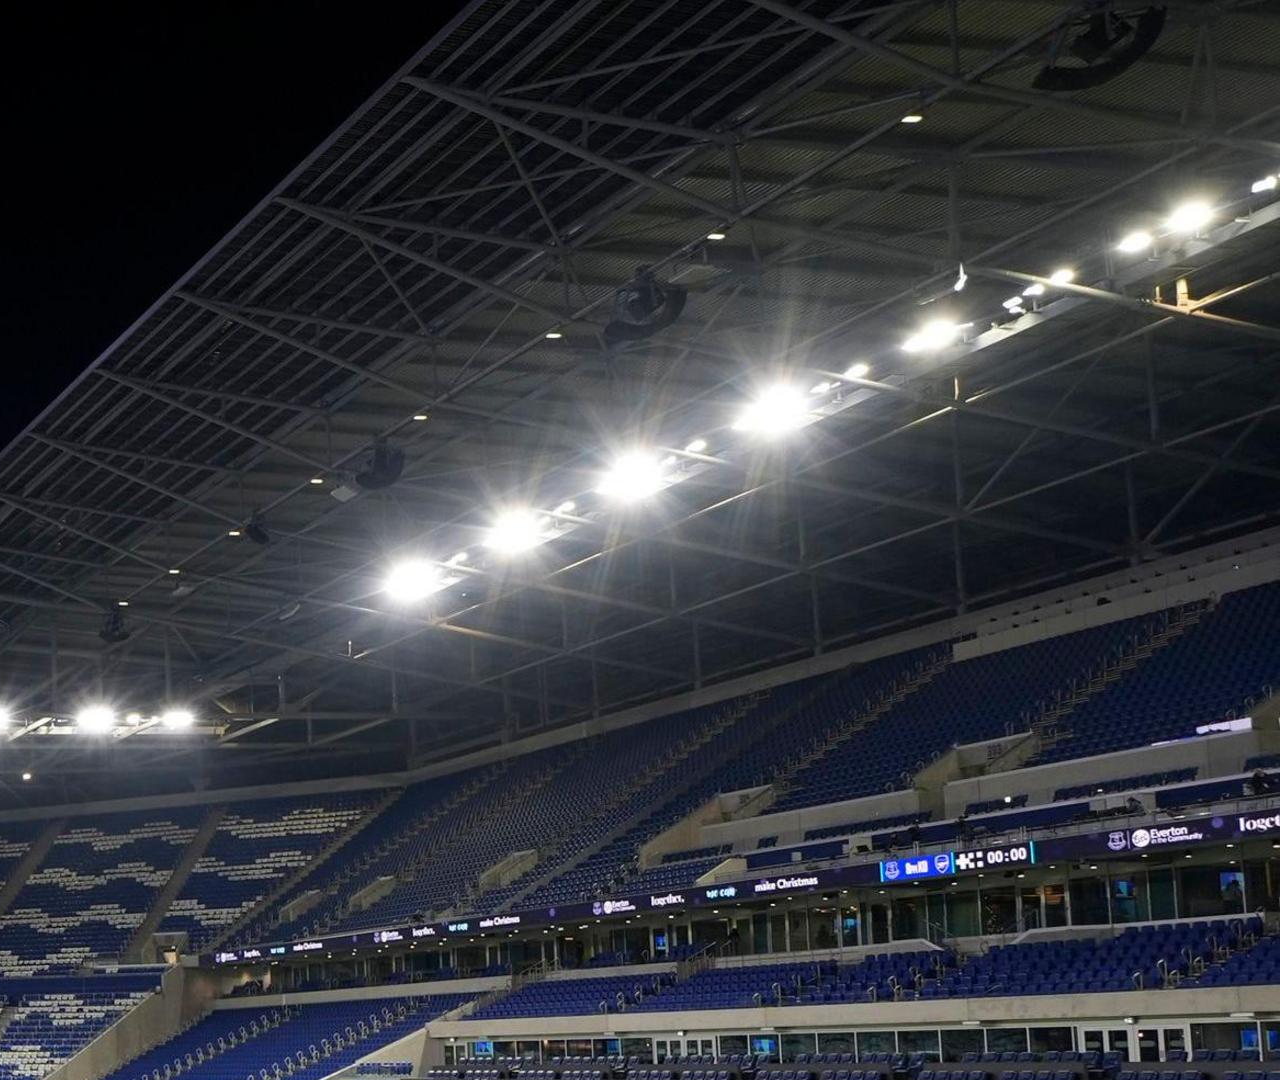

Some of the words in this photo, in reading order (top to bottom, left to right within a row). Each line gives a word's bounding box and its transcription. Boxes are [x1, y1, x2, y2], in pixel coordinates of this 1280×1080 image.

[1150, 827, 1188, 840] Everton
[1168, 833, 1203, 843] Community
[987, 847, 1028, 864] 00:00
[755, 881, 776, 892] make
[776, 877, 818, 889] Christmas
